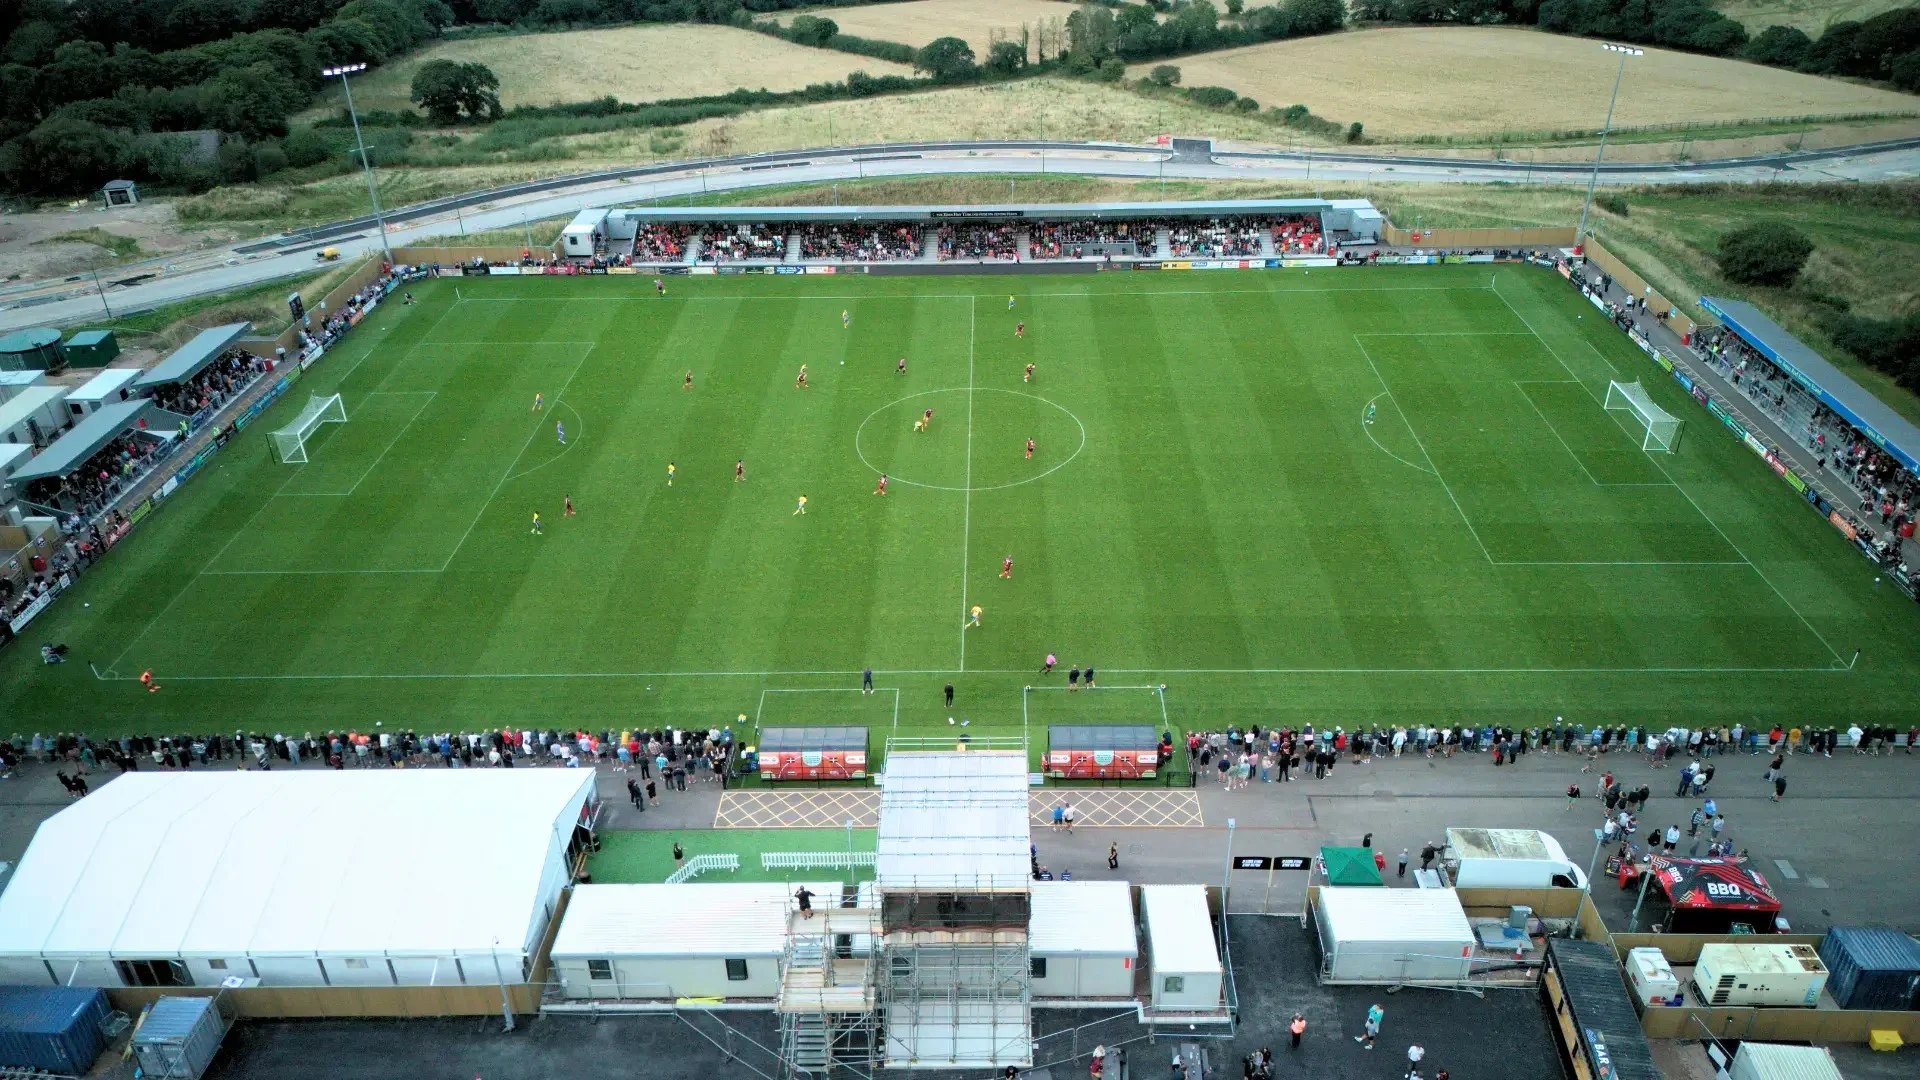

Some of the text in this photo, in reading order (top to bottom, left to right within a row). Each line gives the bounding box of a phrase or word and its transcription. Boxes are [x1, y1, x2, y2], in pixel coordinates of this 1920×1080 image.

[1669, 867, 1684, 883] BBQ
[1707, 883, 1740, 895] BBQ
[1594, 1044, 1610, 1064] BAR
